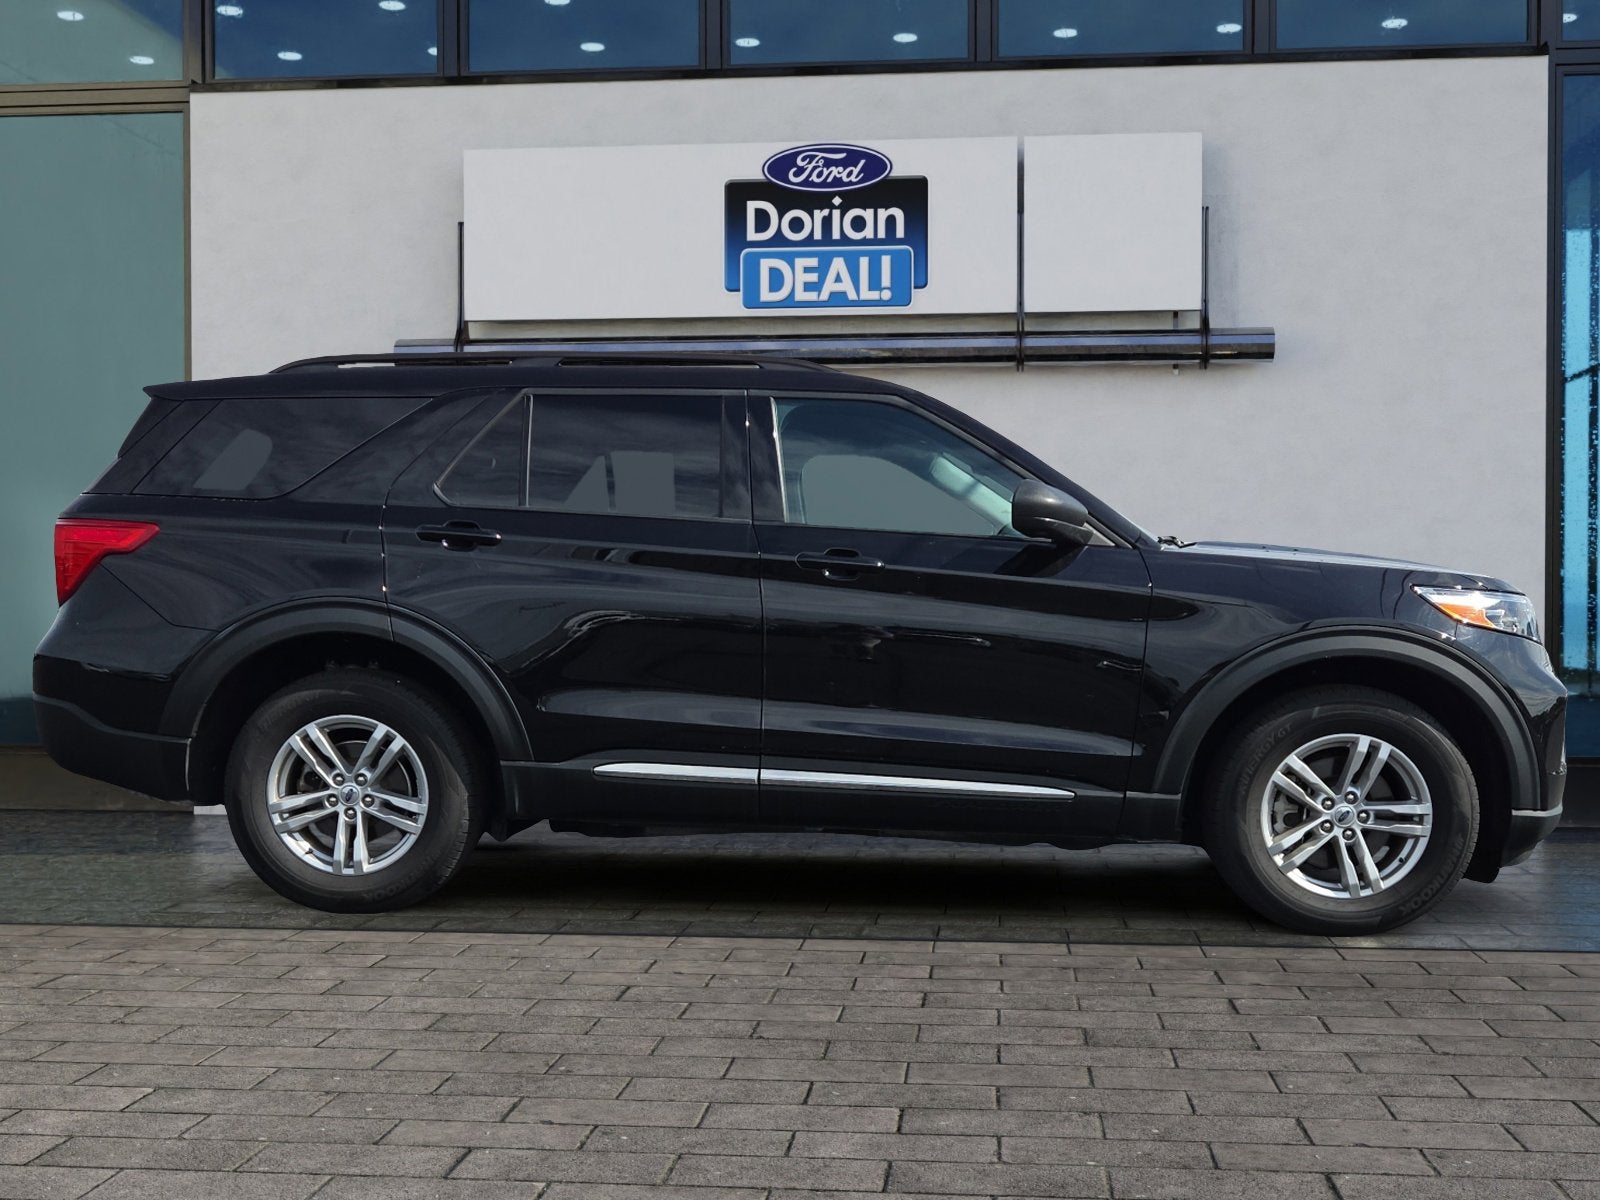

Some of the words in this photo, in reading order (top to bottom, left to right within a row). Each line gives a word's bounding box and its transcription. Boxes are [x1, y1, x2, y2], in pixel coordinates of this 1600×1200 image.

[788, 151, 866, 183] Ford
[746, 195, 905, 242] Dorian
[759, 255, 892, 302] DEAL!
